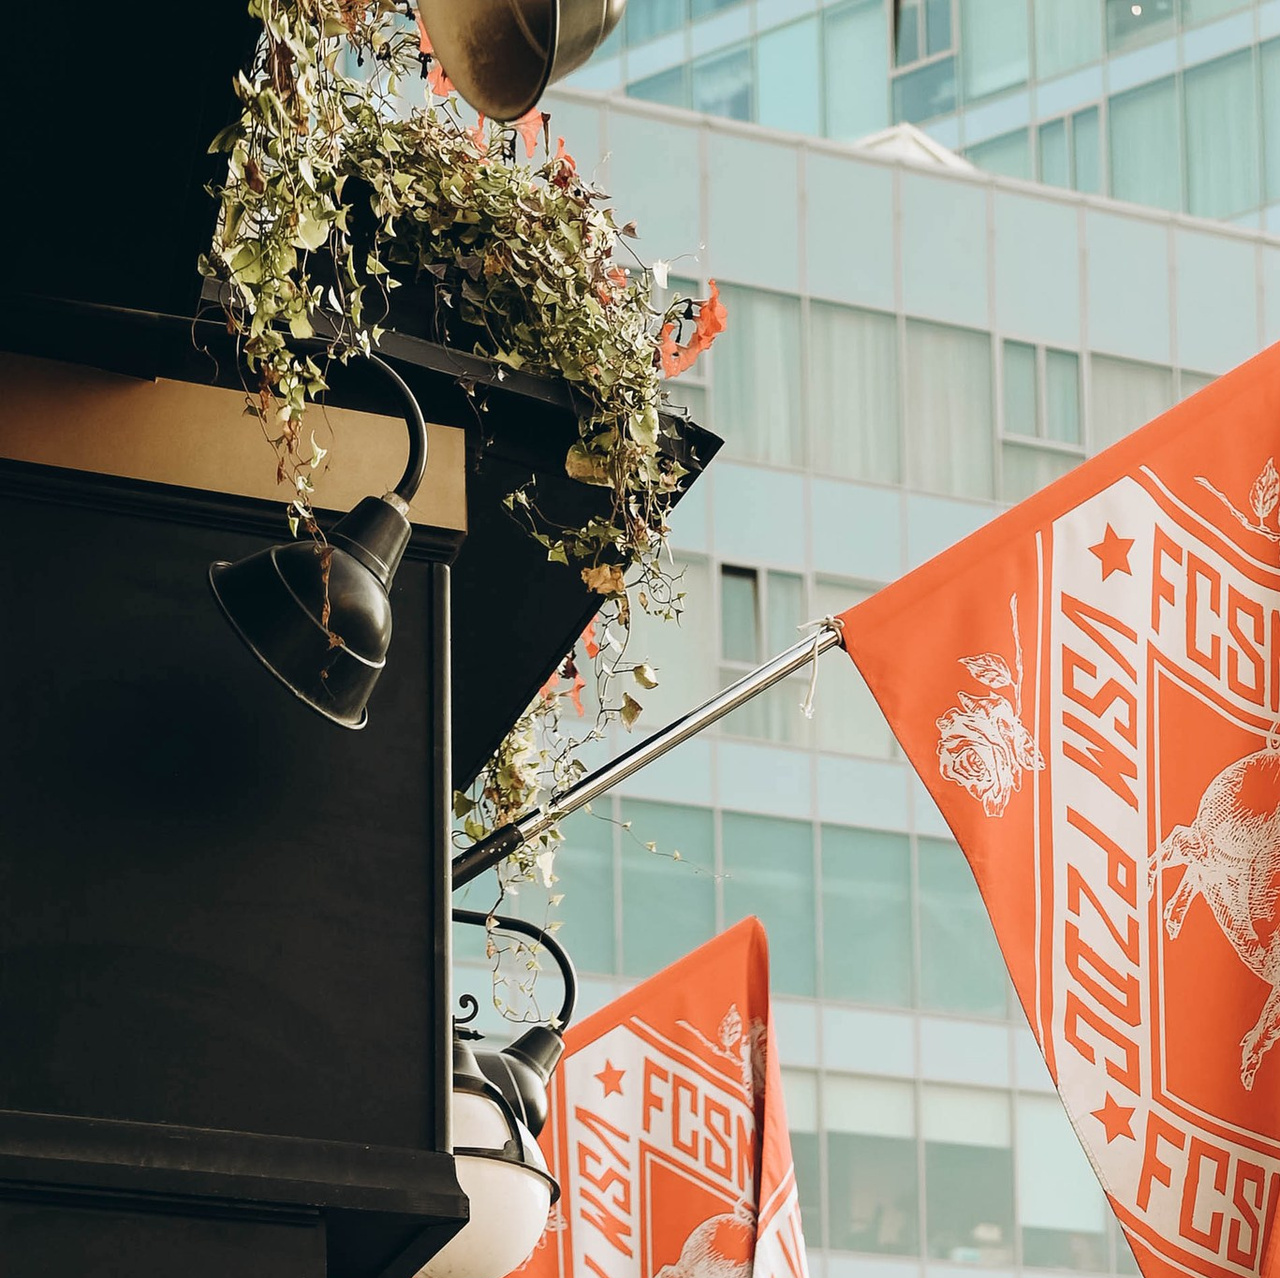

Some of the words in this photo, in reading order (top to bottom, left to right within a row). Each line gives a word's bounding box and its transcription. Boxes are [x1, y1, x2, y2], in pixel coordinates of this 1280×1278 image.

[1060, 590, 1139, 813] VSM
[1064, 805, 1142, 1097] PZDC
[574, 1105, 633, 1259] VSM
